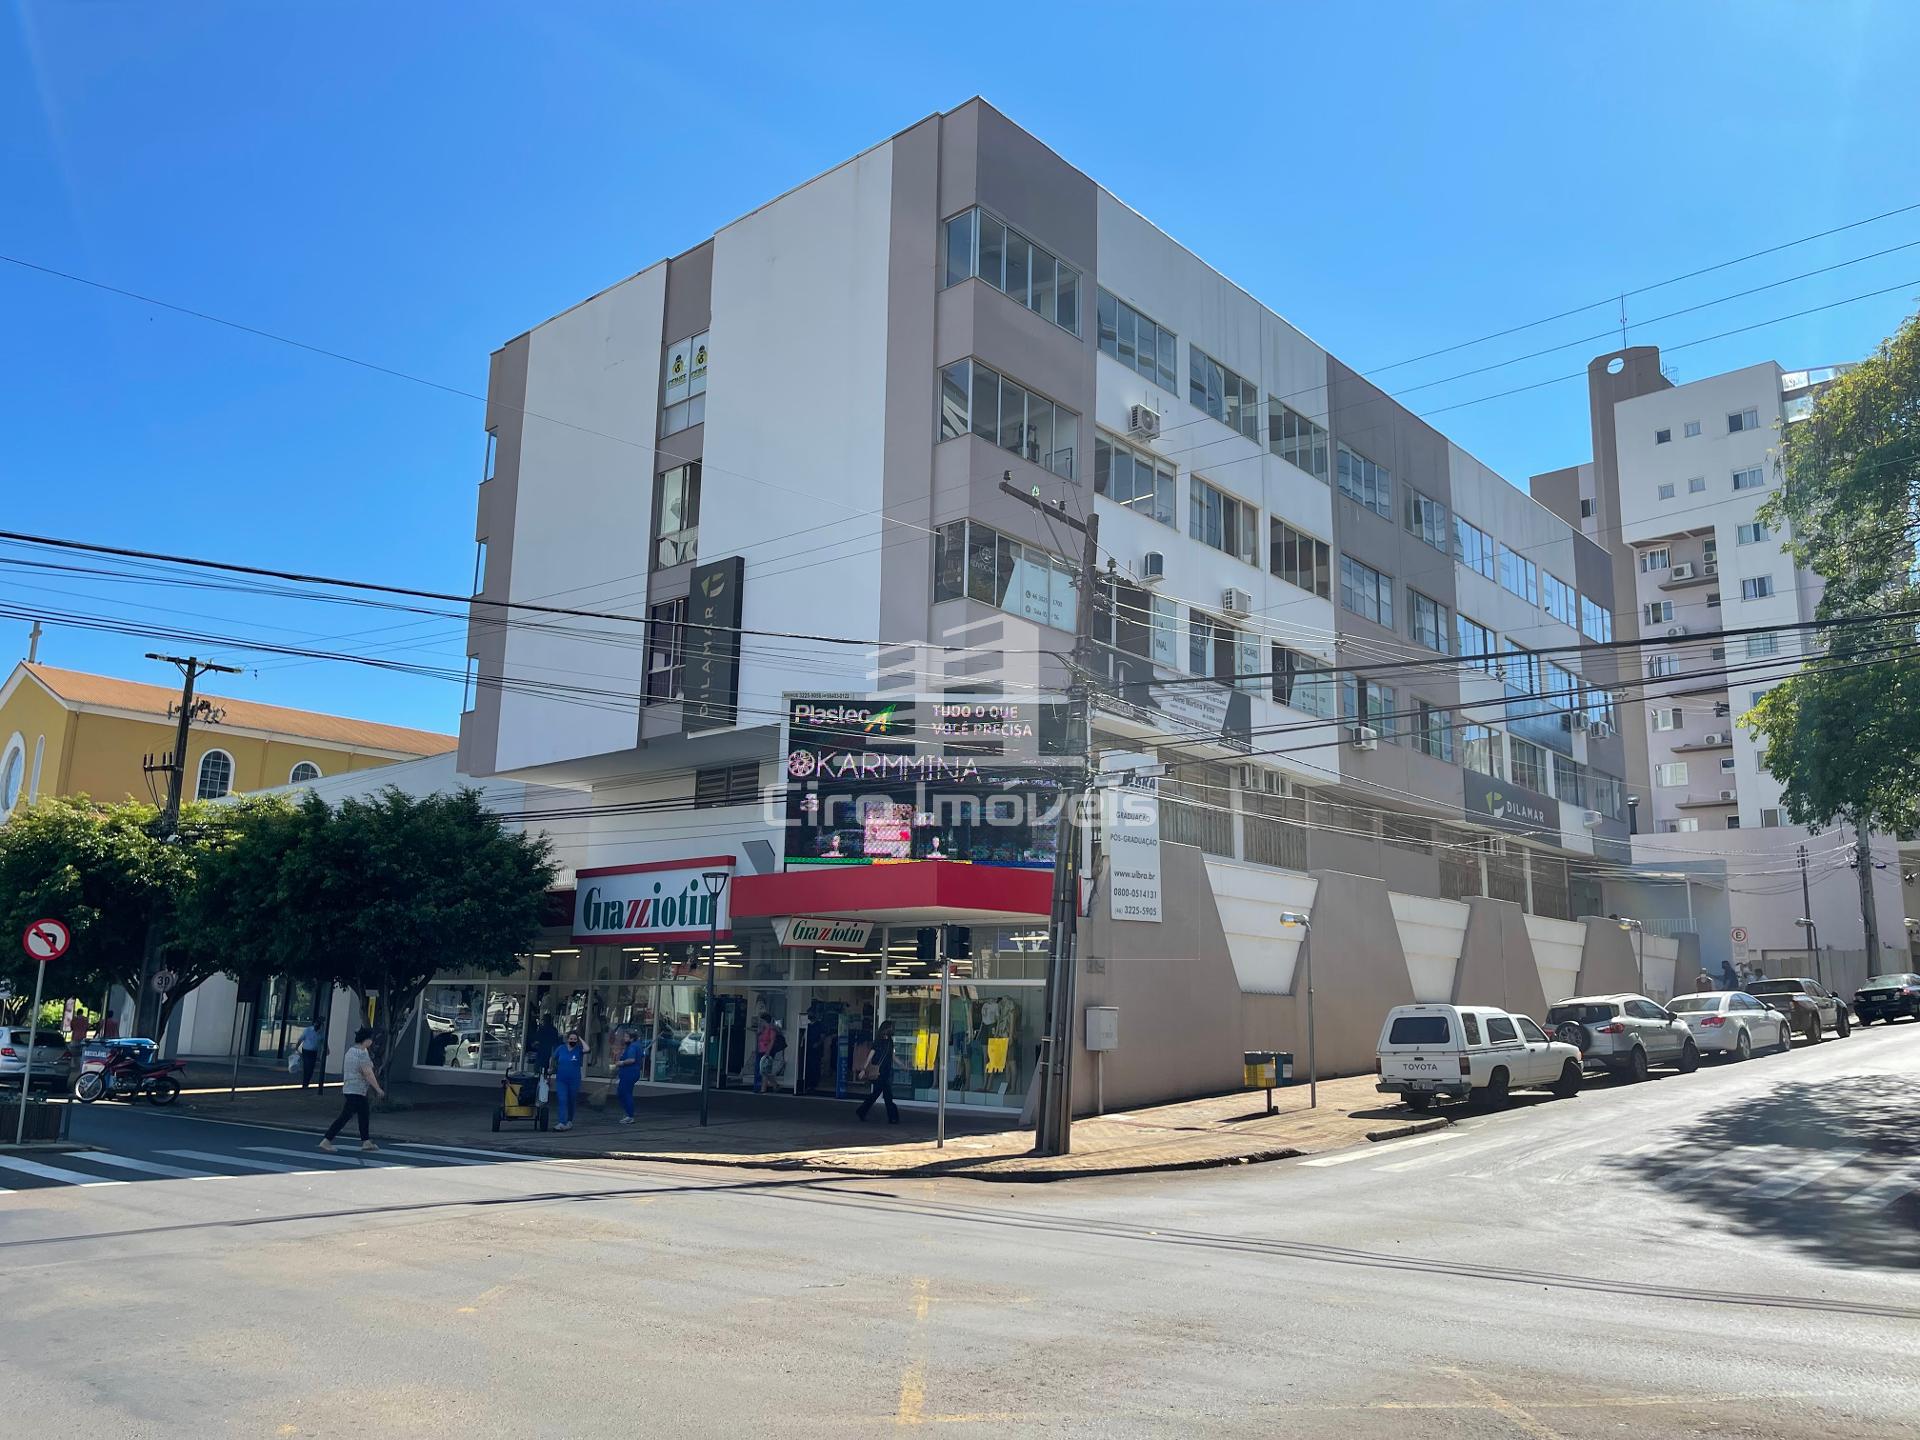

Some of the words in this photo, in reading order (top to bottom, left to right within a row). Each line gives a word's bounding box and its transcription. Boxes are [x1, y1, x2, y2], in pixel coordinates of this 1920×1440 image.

[700, 606, 714, 717] DILAMAR
[795, 704, 870, 723] Plastec
[932, 704, 971, 718] TUDO
[975, 705, 985, 718] O
[989, 705, 1018, 719] QUE
[973, 723, 1033, 737] PRECISA
[816, 751, 982, 783] KARMMINA
[1116, 810, 1151, 823] GRADUAÇÃO
[1506, 801, 1544, 823] DILAMAR
[1110, 833, 1157, 847] PÓS-GRADUAÇÃO
[1114, 870, 1156, 880] www.ulbra.br
[1113, 887, 1157, 899] 0800-0514131
[583, 879, 714, 931] Grazziotin
[1124, 905, 1157, 916] 3225-5905
[792, 920, 864, 943] Grazziotin
[157, 975, 170, 987] 30
[1402, 1063, 1438, 1071] TOYOTA
